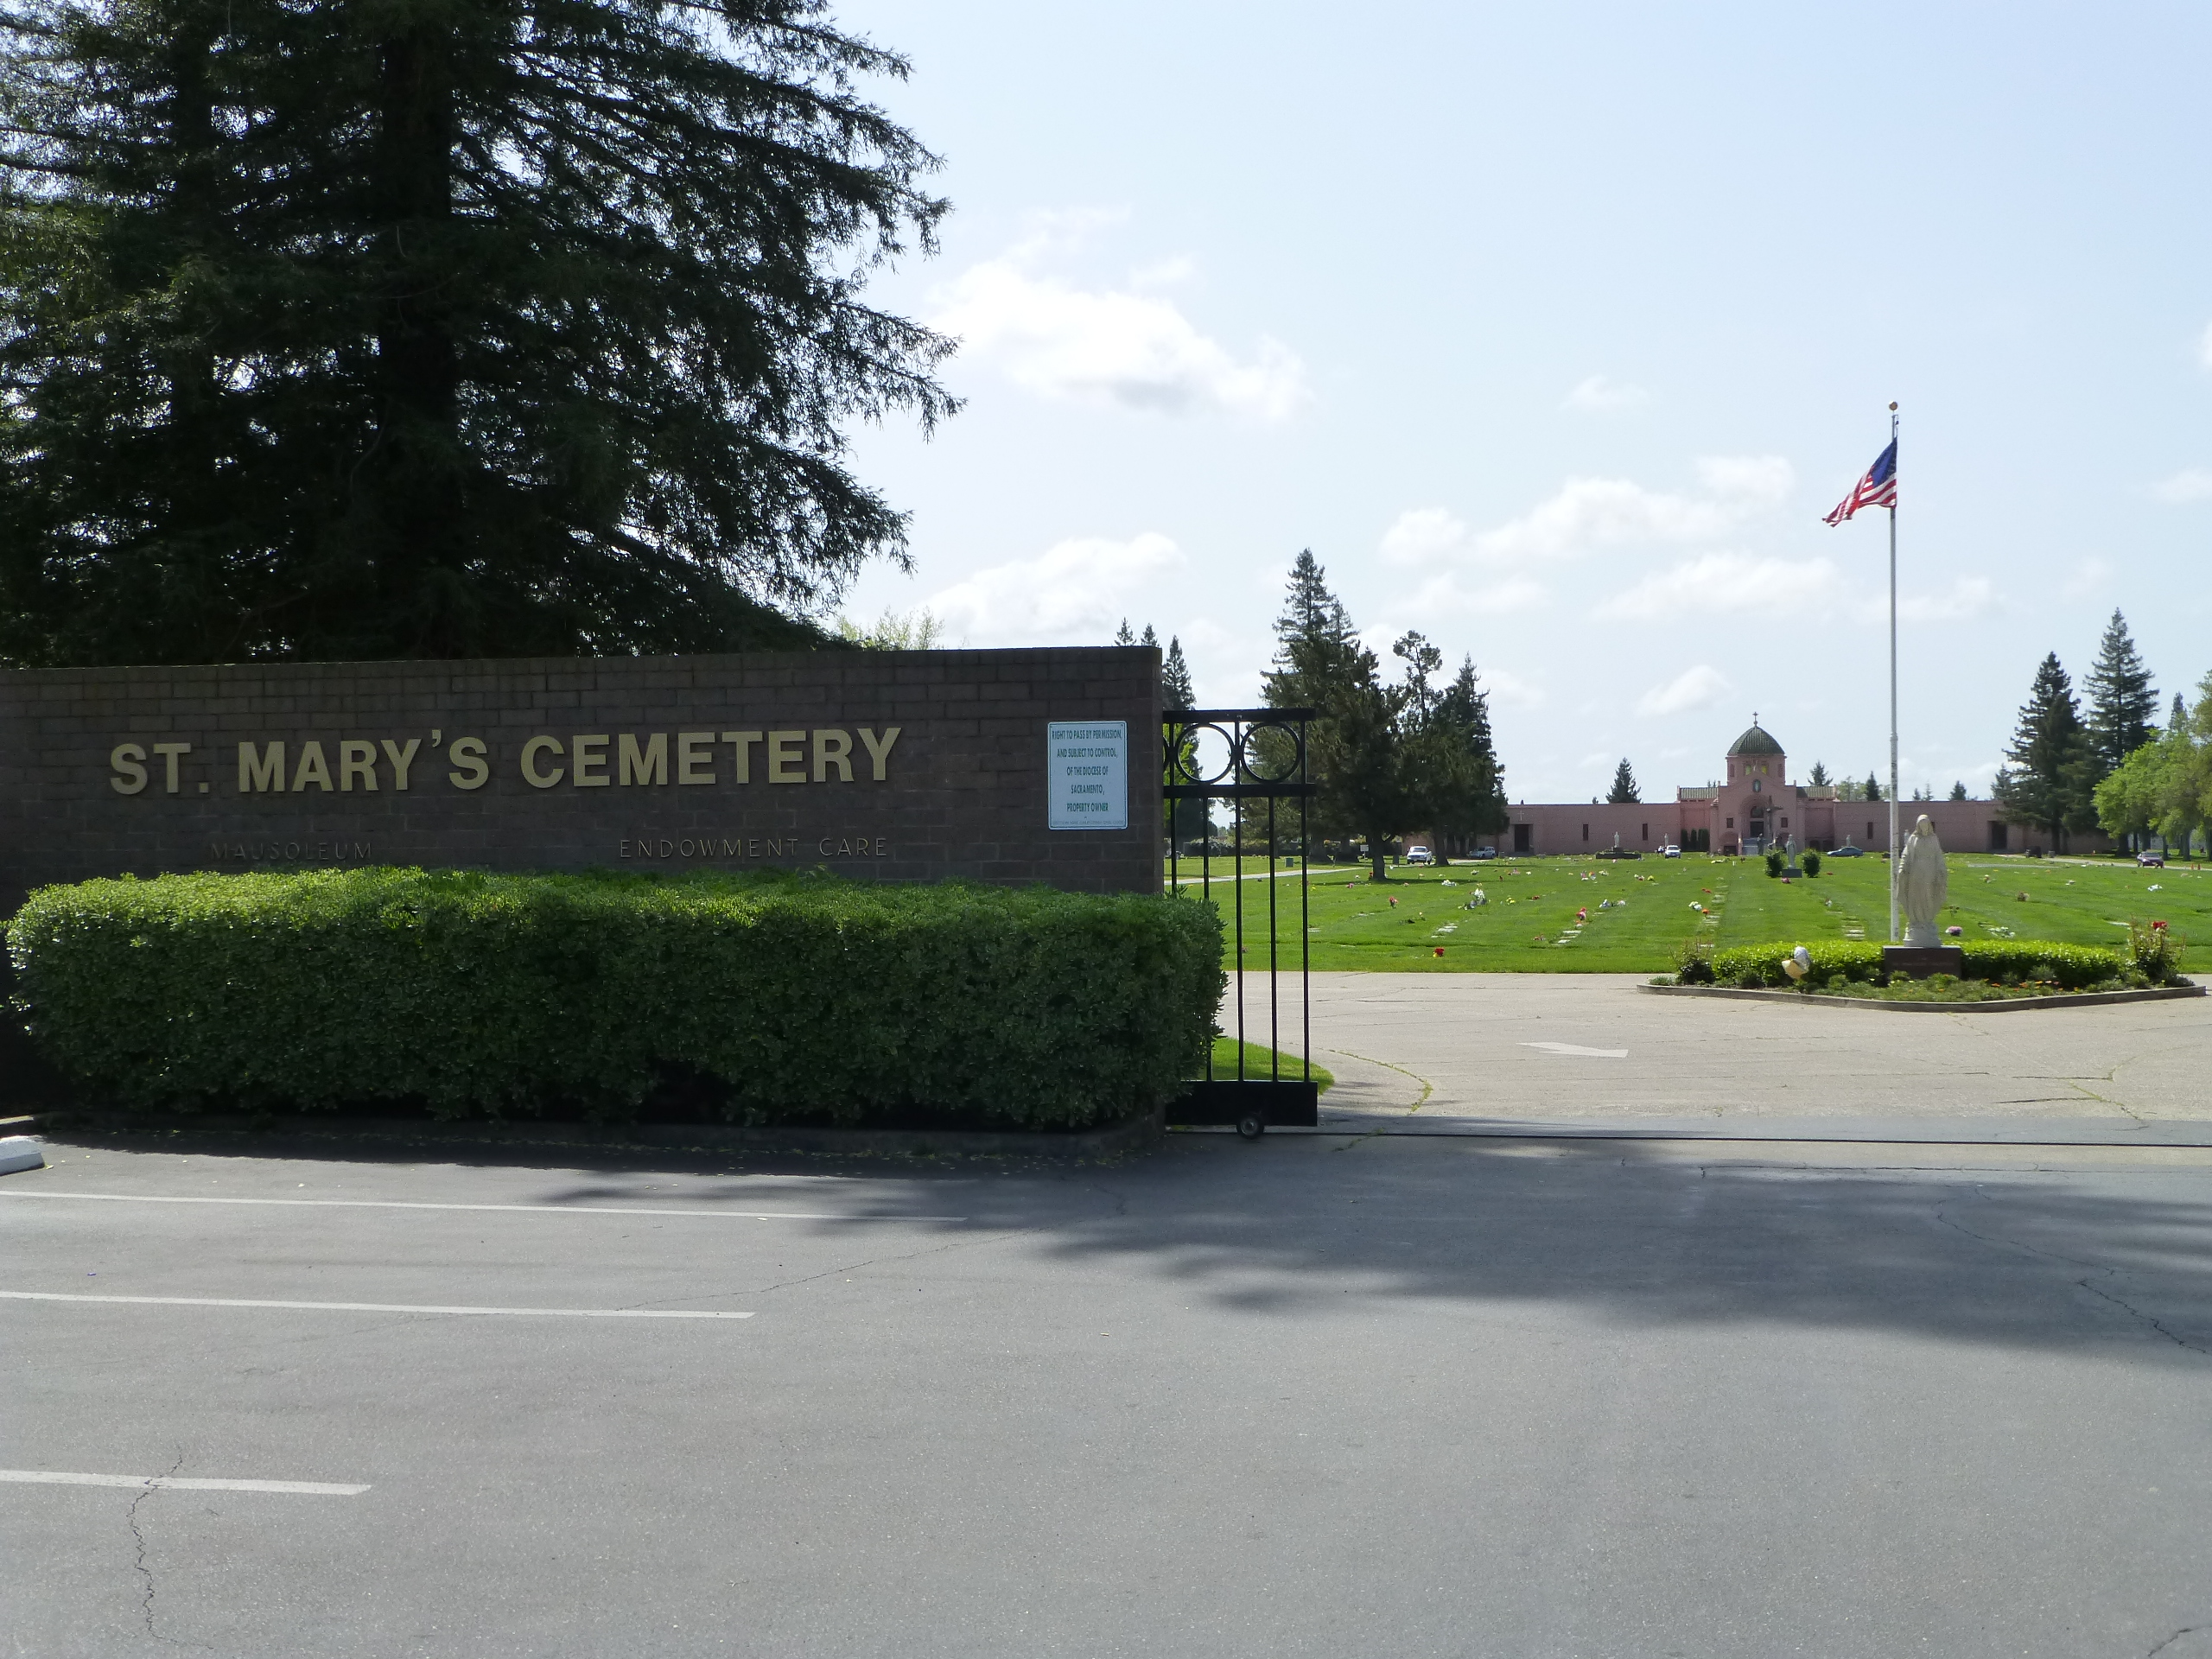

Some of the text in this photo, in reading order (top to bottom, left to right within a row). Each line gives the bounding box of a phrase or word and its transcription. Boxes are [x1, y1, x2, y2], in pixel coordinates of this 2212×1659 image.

[1052, 730, 1066, 740] RIGHT
[1066, 730, 1073, 739] TO
[1073, 730, 1085, 739] PASS
[1086, 729, 1092, 738] BY
[1057, 748, 1067, 758] AND
[1067, 748, 1087, 758] SUBJECT
[1087, 748, 1094, 757] TO
[111, 728, 901, 795] ST. MARY'S CEMETERY
[1066, 766, 1109, 776] OF THE DIOCESE OF
[1066, 803, 1109, 812] PROPERTY OWNER
[210, 842, 372, 860] MAUSOLEUM
[620, 837, 887, 858] ENDOWMENT CARE
